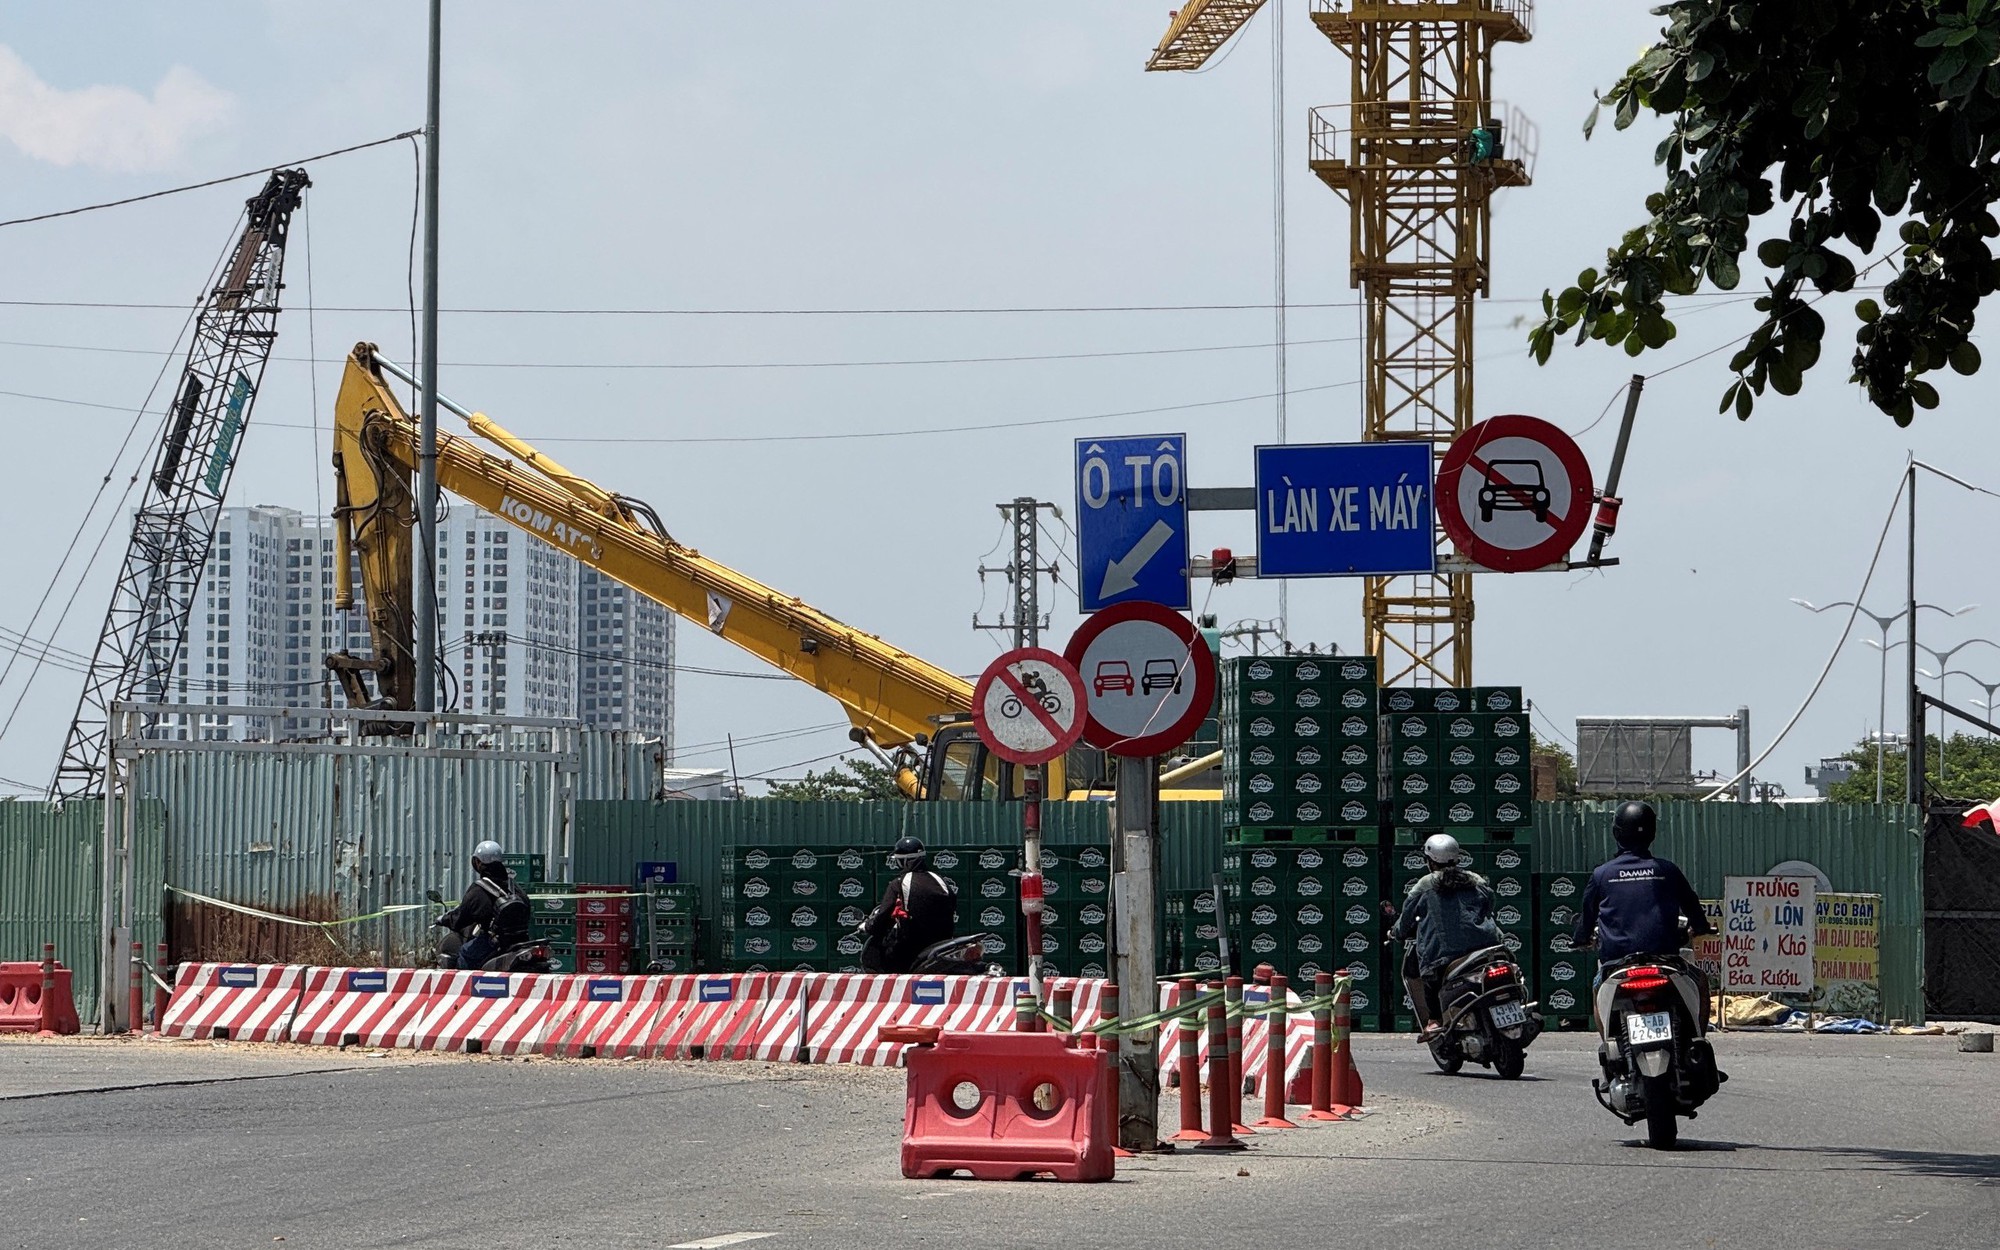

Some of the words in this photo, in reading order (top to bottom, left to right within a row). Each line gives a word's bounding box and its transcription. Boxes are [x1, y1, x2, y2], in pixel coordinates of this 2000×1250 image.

[1083, 443, 1110, 509] Ô
[1124, 441, 1179, 508] TÔ
[1268, 476, 1318, 534] LÀN
[1329, 487, 1360, 531] XE
[1369, 473, 1423, 531] MÁY
[1619, 869, 1654, 878] DAMIAN
[1746, 876, 1800, 897] TRỨNG
[1774, 900, 1804, 930] LỘN
[1777, 933, 1807, 956] Khô
[1728, 970, 1756, 986] Bia
